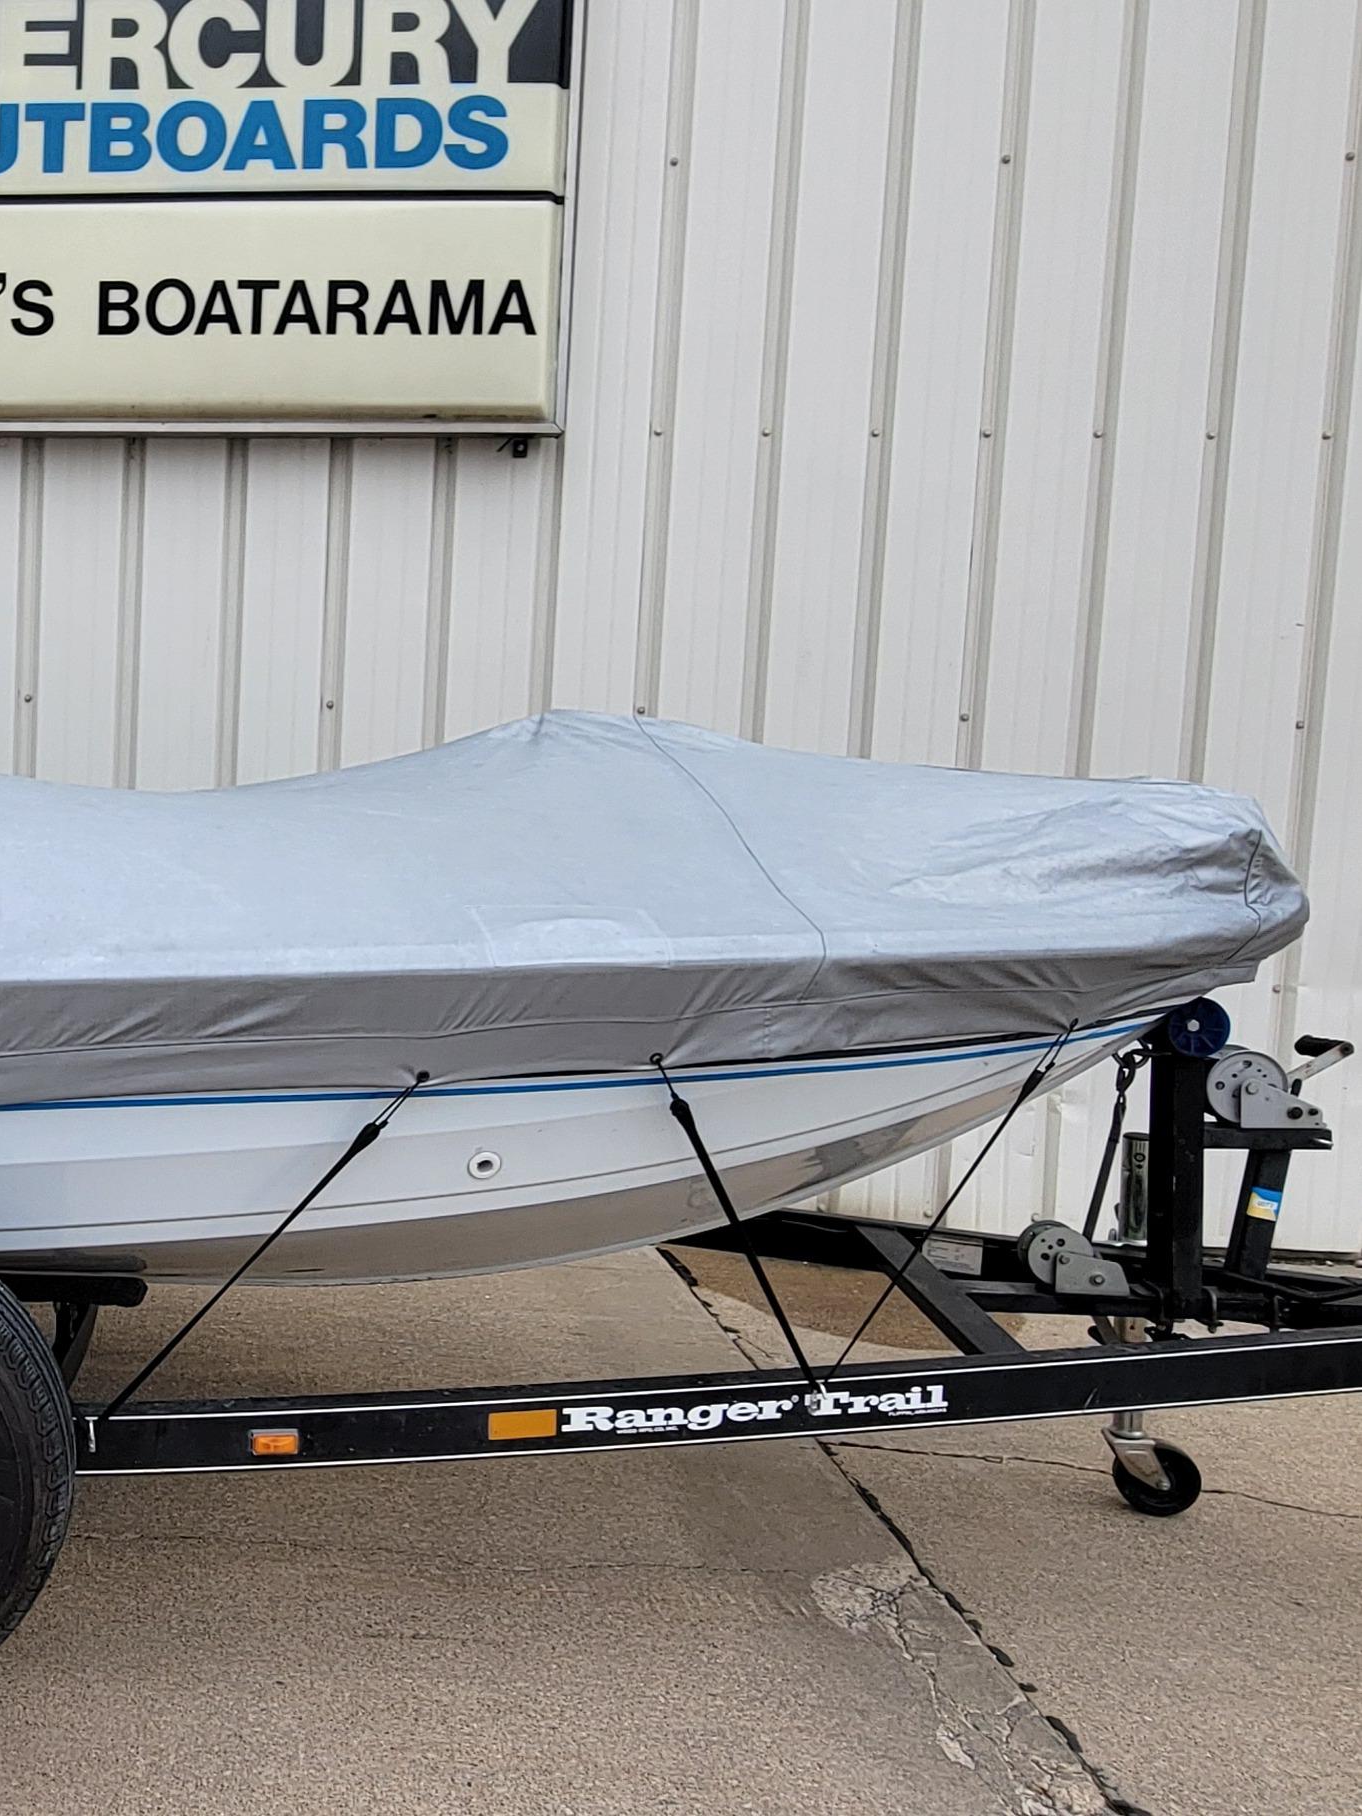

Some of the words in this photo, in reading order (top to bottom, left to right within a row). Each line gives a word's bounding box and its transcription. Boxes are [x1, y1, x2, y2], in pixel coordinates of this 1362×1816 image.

[98, 278, 537, 336] BOATARAMA
[561, 1399, 794, 1434] Ranger
[804, 1385, 949, 1416] Trail
